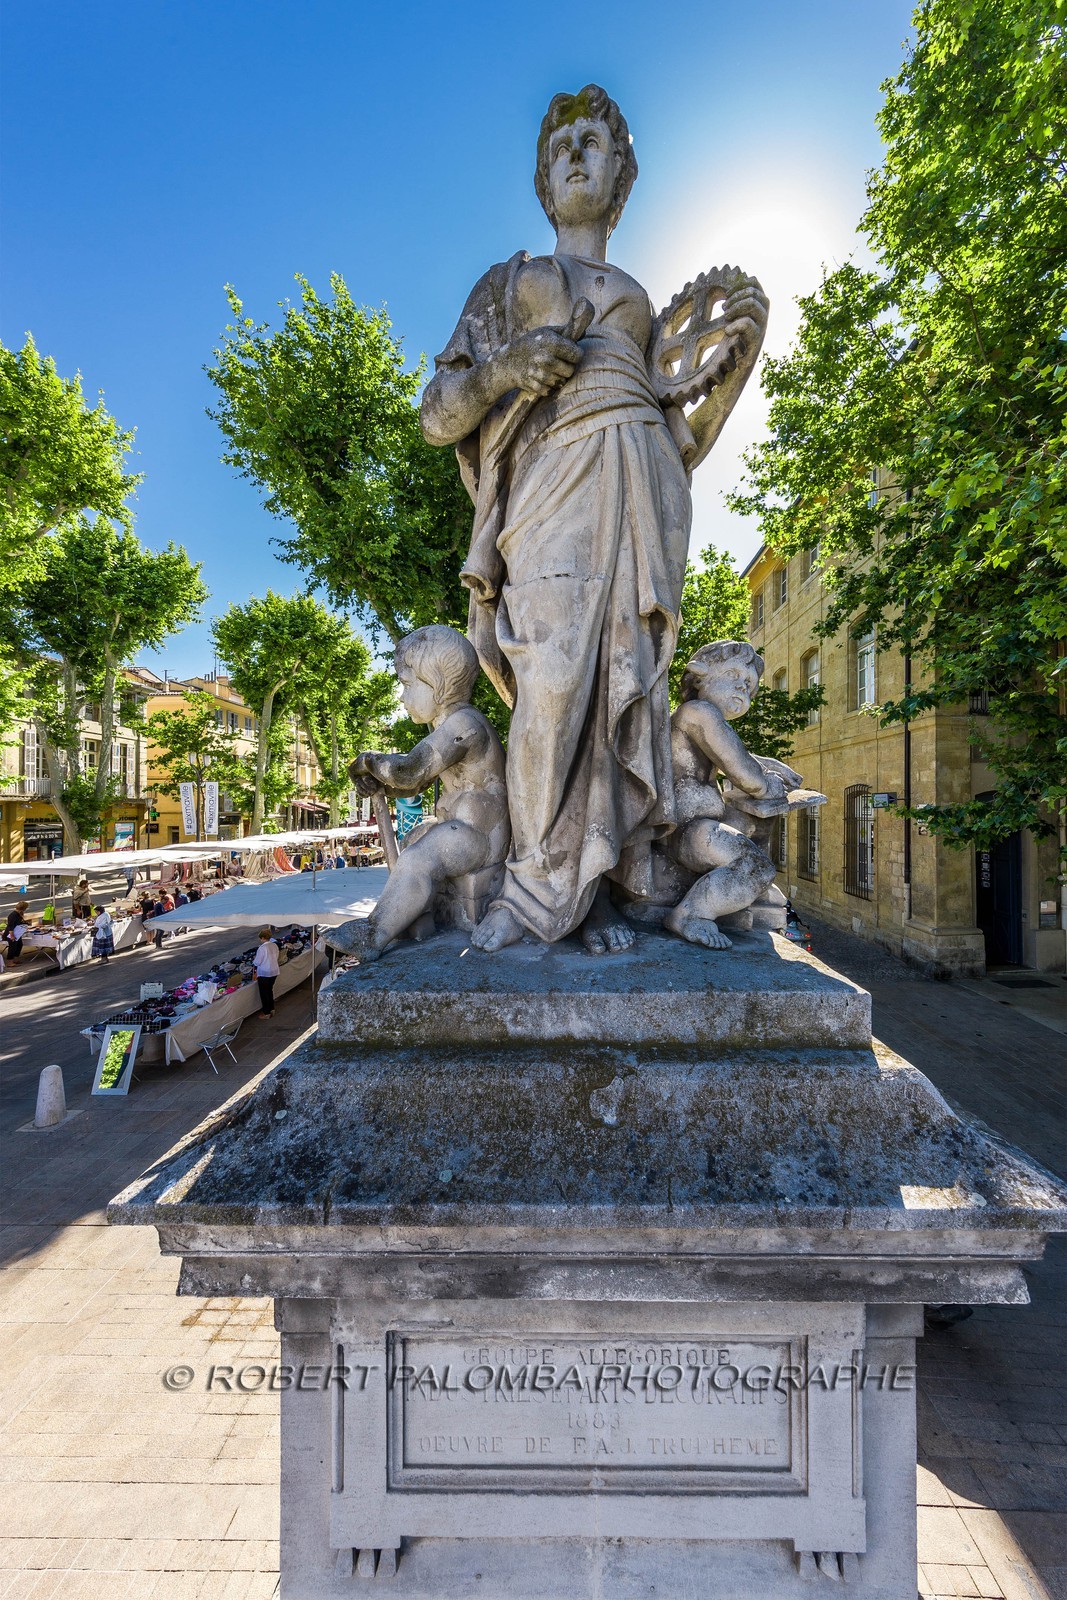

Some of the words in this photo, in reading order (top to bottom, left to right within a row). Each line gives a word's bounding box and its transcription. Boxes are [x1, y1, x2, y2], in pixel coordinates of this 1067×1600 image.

[207, 784, 215, 829] #aixmaville
[463, 1348, 553, 1365] GROUPE
[567, 1411, 621, 1430] 1883
[419, 1435, 503, 1453] OEUVRE
[525, 1436, 552, 1454] DE
